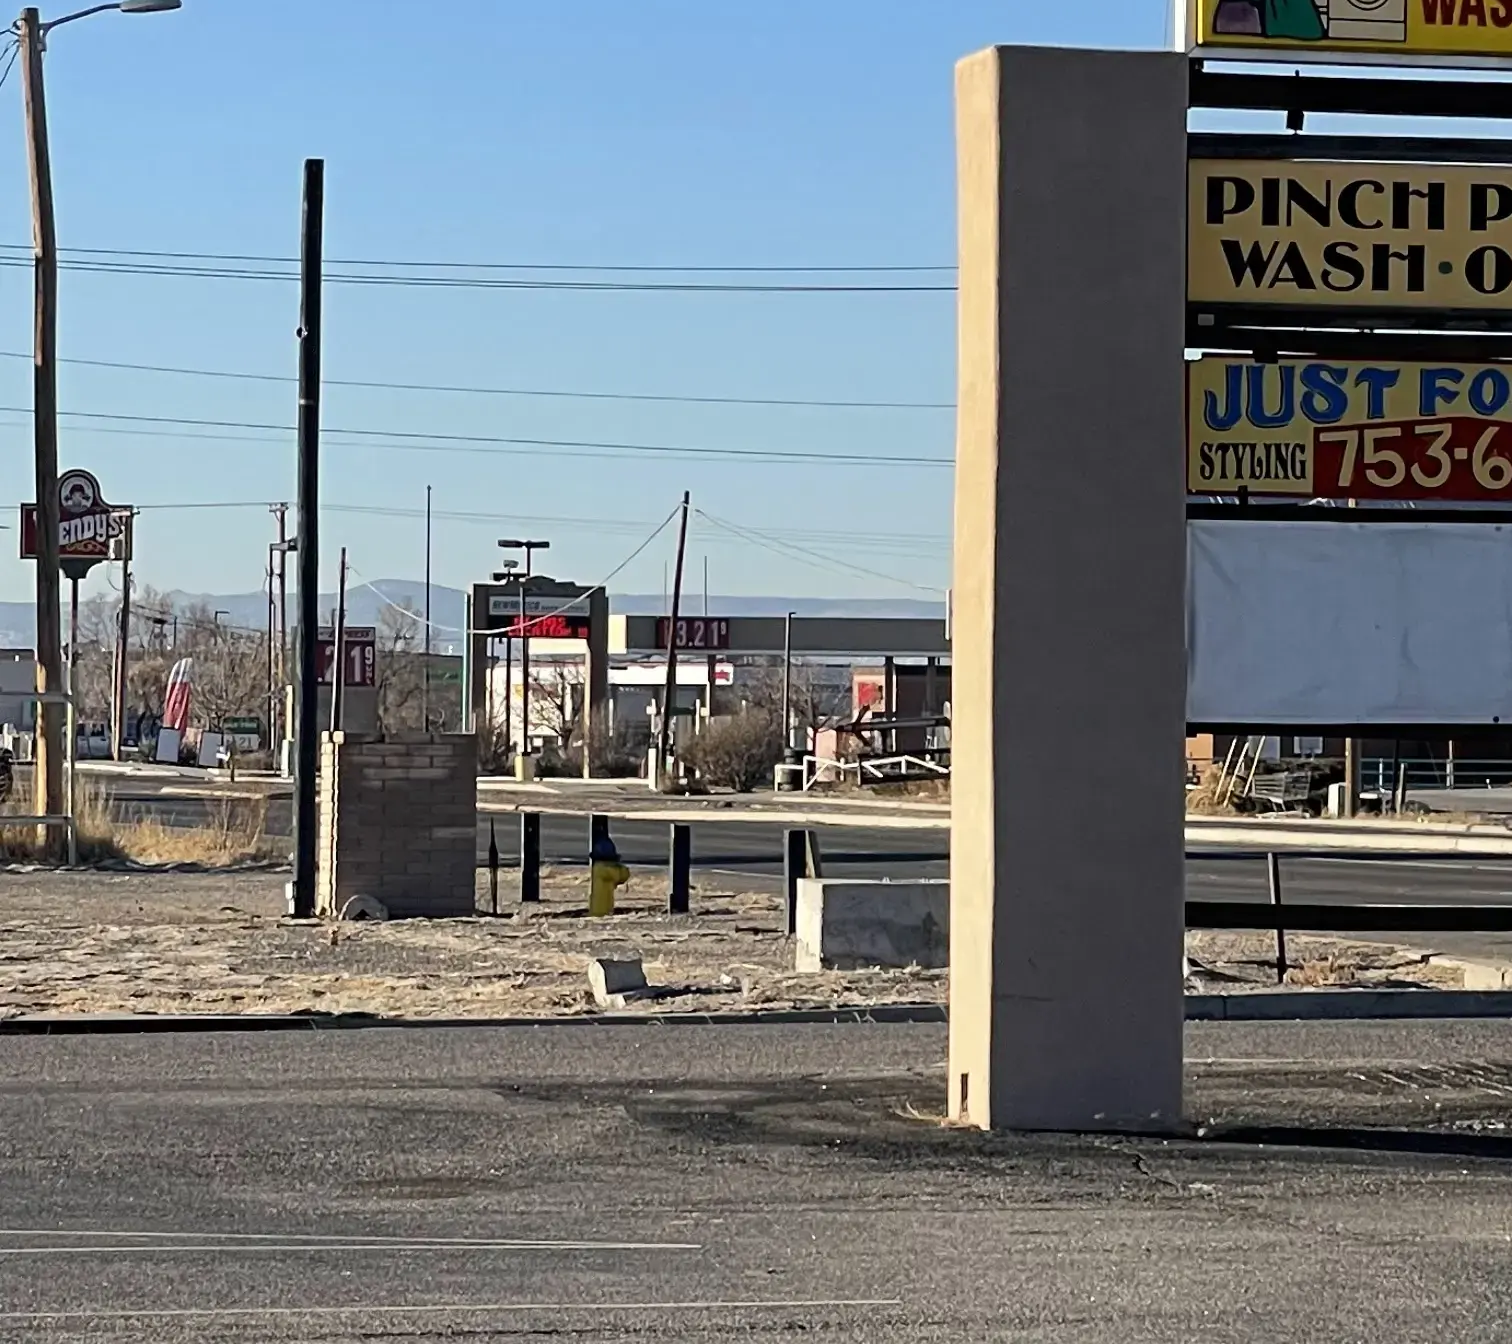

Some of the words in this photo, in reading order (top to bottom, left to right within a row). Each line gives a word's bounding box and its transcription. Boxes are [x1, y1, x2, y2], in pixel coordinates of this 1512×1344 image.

[1205, 175, 1446, 231] PINCH
[1203, 363, 1401, 432] JUST
[1199, 440, 1308, 482] STYLING
